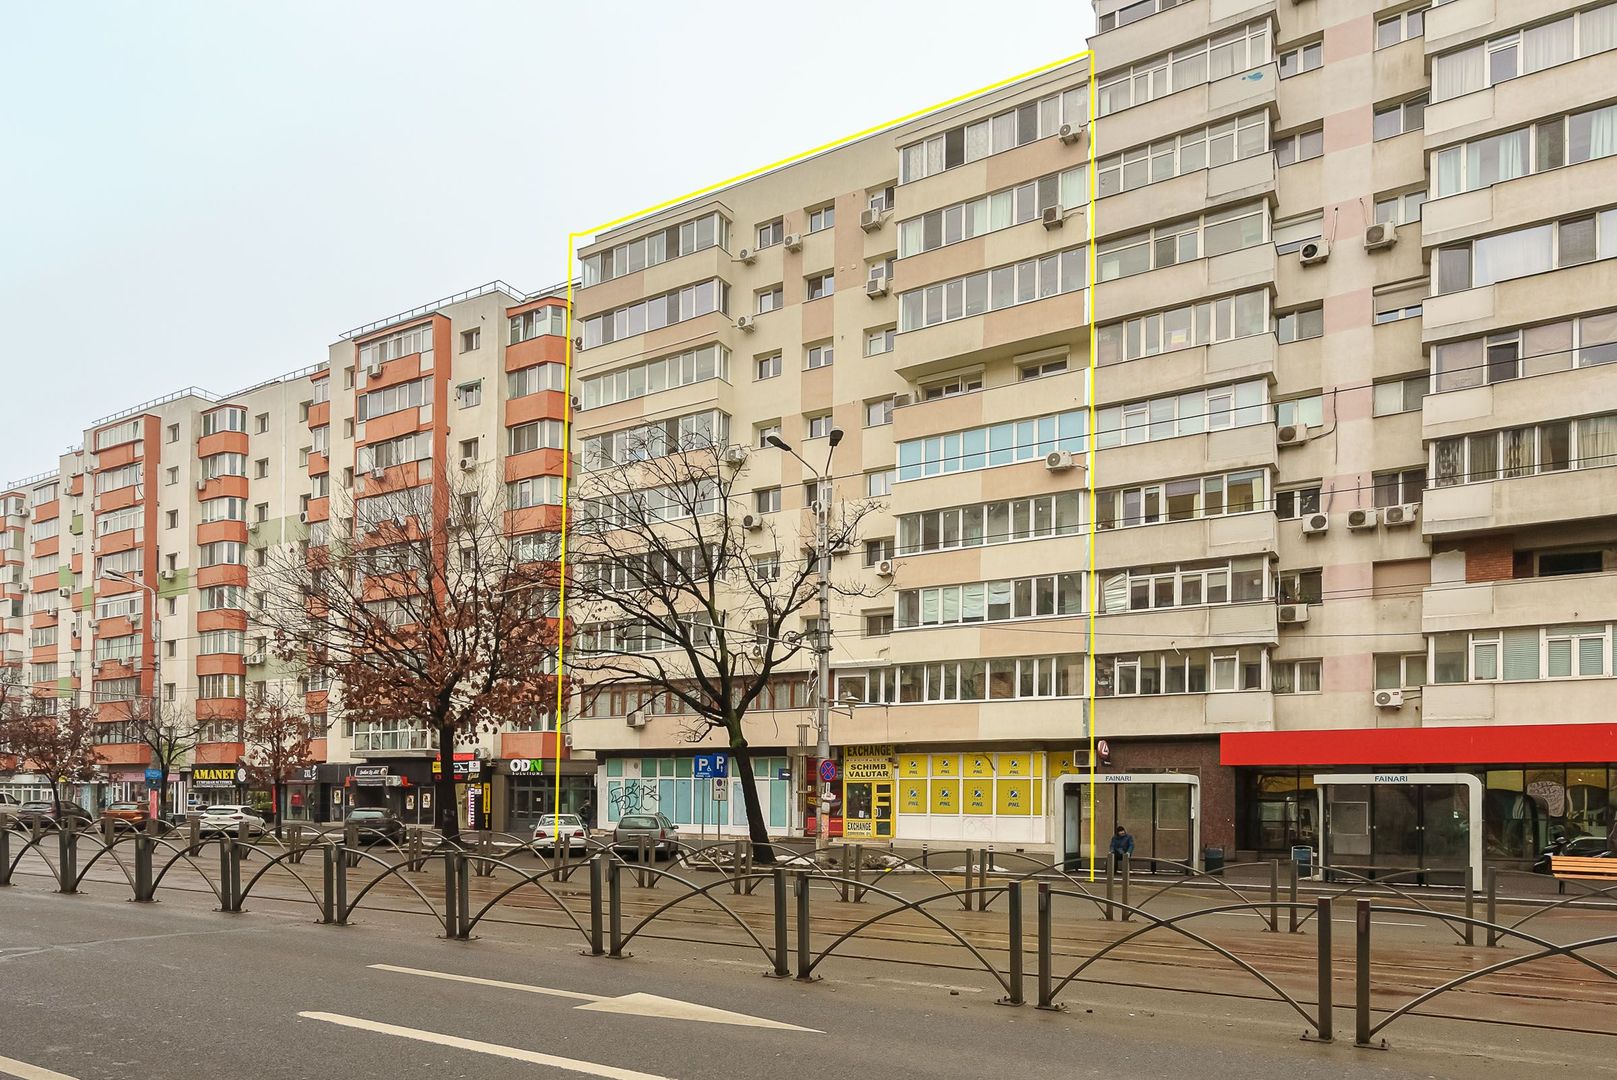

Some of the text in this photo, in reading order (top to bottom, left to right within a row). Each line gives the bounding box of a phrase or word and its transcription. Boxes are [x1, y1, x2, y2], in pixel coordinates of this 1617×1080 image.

[847, 744, 892, 757] EXCHANGE
[510, 759, 542, 772] ODN
[698, 758, 709, 772] P
[716, 756, 725, 770] P
[193, 769, 236, 780] AMANET
[847, 822, 872, 831] EXCHANGE
